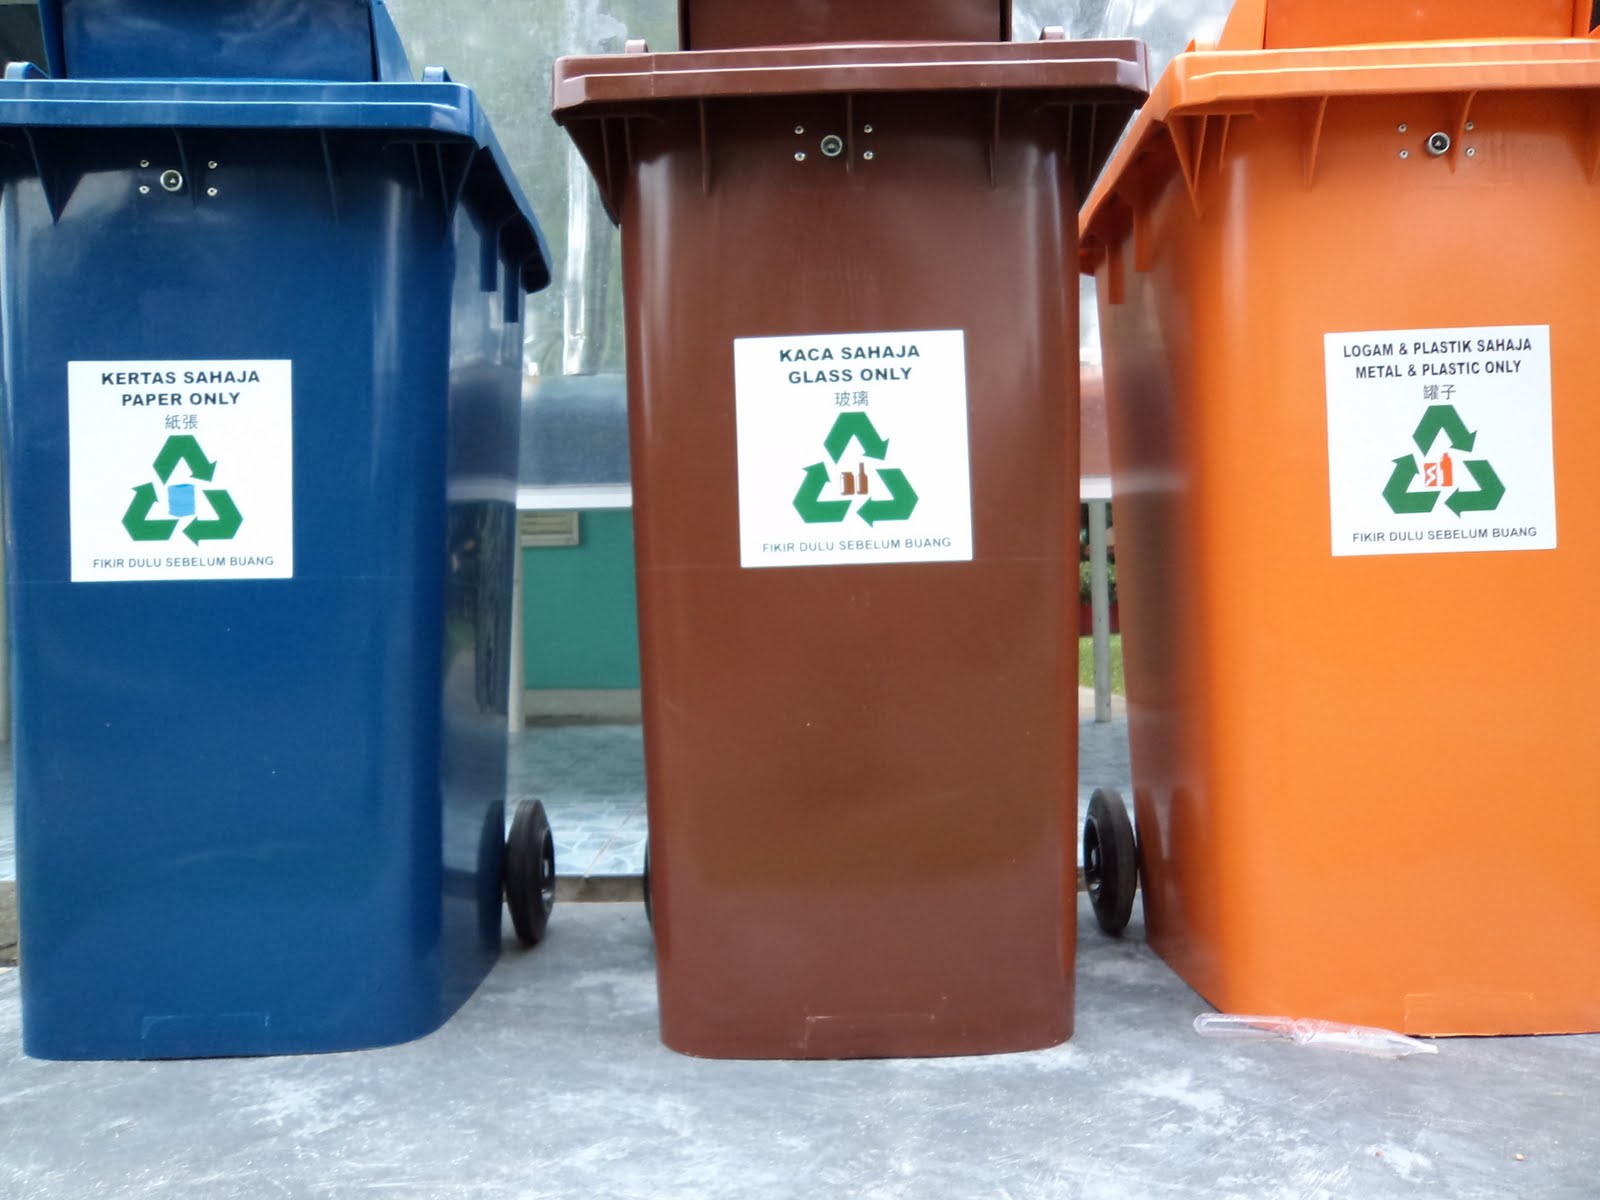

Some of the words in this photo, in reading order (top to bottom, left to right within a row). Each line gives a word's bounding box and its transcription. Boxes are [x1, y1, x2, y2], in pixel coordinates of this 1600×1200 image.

[779, 348, 834, 362] KACA
[841, 345, 920, 360] SAHAJA
[1344, 344, 1393, 357] LOGAM
[1399, 343, 1408, 355] &
[1413, 340, 1472, 355] PLASTIK
[1477, 338, 1532, 352] SAHAJA
[101, 372, 177, 385] KERTAS
[184, 370, 260, 384] SAHAJA
[788, 369, 853, 384] GLASS
[860, 367, 912, 381] ONLY
[1356, 366, 1402, 379] METAL
[1408, 364, 1417, 376] &
[1422, 362, 1479, 376] PLASTIC
[1485, 360, 1521, 374] ONLY
[122, 394, 182, 406] PAPER
[189, 392, 240, 405] ONLY
[835, 391, 869, 407] 玻璃
[1423, 384, 1456, 400] 罐子
[165, 414, 198, 430] 紙張
[1353, 533, 1385, 542] FIKIR
[1390, 531, 1423, 541] DULU
[1428, 529, 1488, 539] SEBELUM
[1492, 527, 1537, 537] BUANG
[763, 543, 795, 552] FIKIR
[800, 542, 834, 552] DULU
[839, 539, 901, 550] SEBELUM
[905, 538, 951, 548] BUANG
[93, 559, 125, 568] FIKIR
[129, 559, 161, 567] DULU
[166, 557, 226, 567] SEBELUM
[230, 556, 274, 566] BUANG
